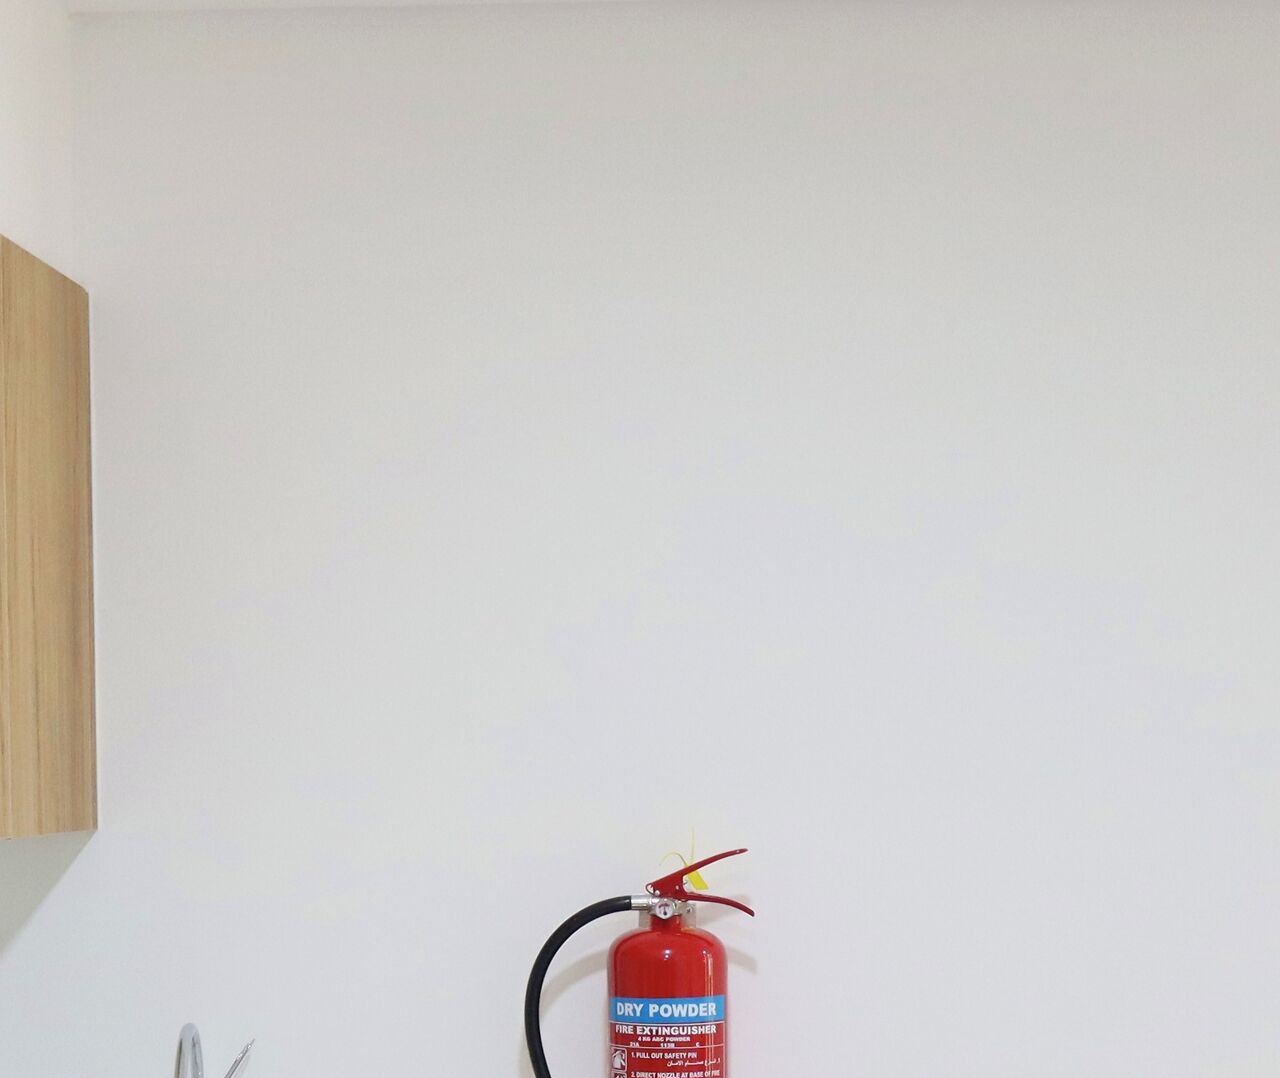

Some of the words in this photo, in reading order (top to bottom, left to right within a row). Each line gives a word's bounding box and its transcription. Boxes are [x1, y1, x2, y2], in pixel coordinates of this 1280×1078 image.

[616, 1002, 644, 1017] DRY
[648, 1002, 717, 1018] POWDER
[615, 1024, 634, 1034] FIRE
[636, 1025, 717, 1036] EXTINGUISHER
